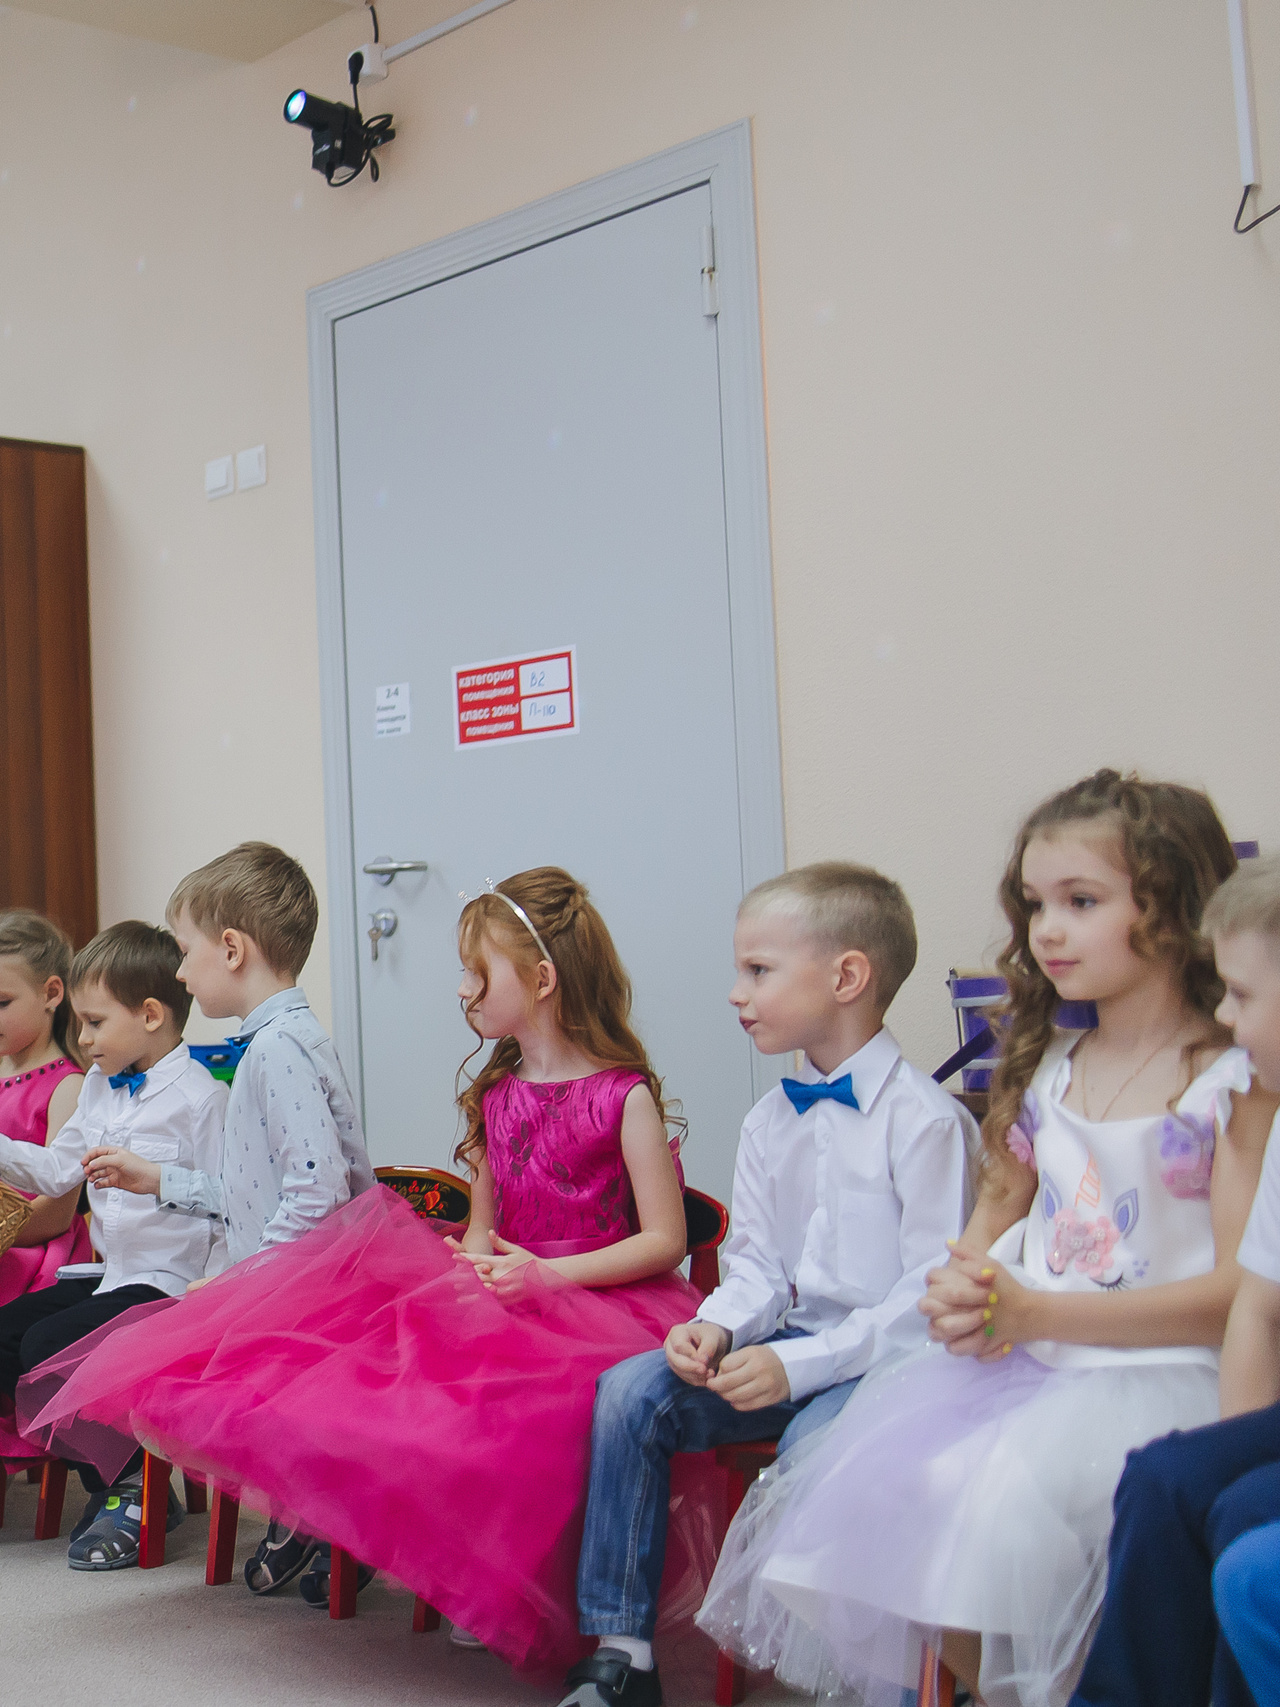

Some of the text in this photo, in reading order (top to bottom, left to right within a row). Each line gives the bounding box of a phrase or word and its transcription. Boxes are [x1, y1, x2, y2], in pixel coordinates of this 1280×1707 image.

[459, 668, 515, 689] категория
[460, 702, 519, 723] класс зоны
